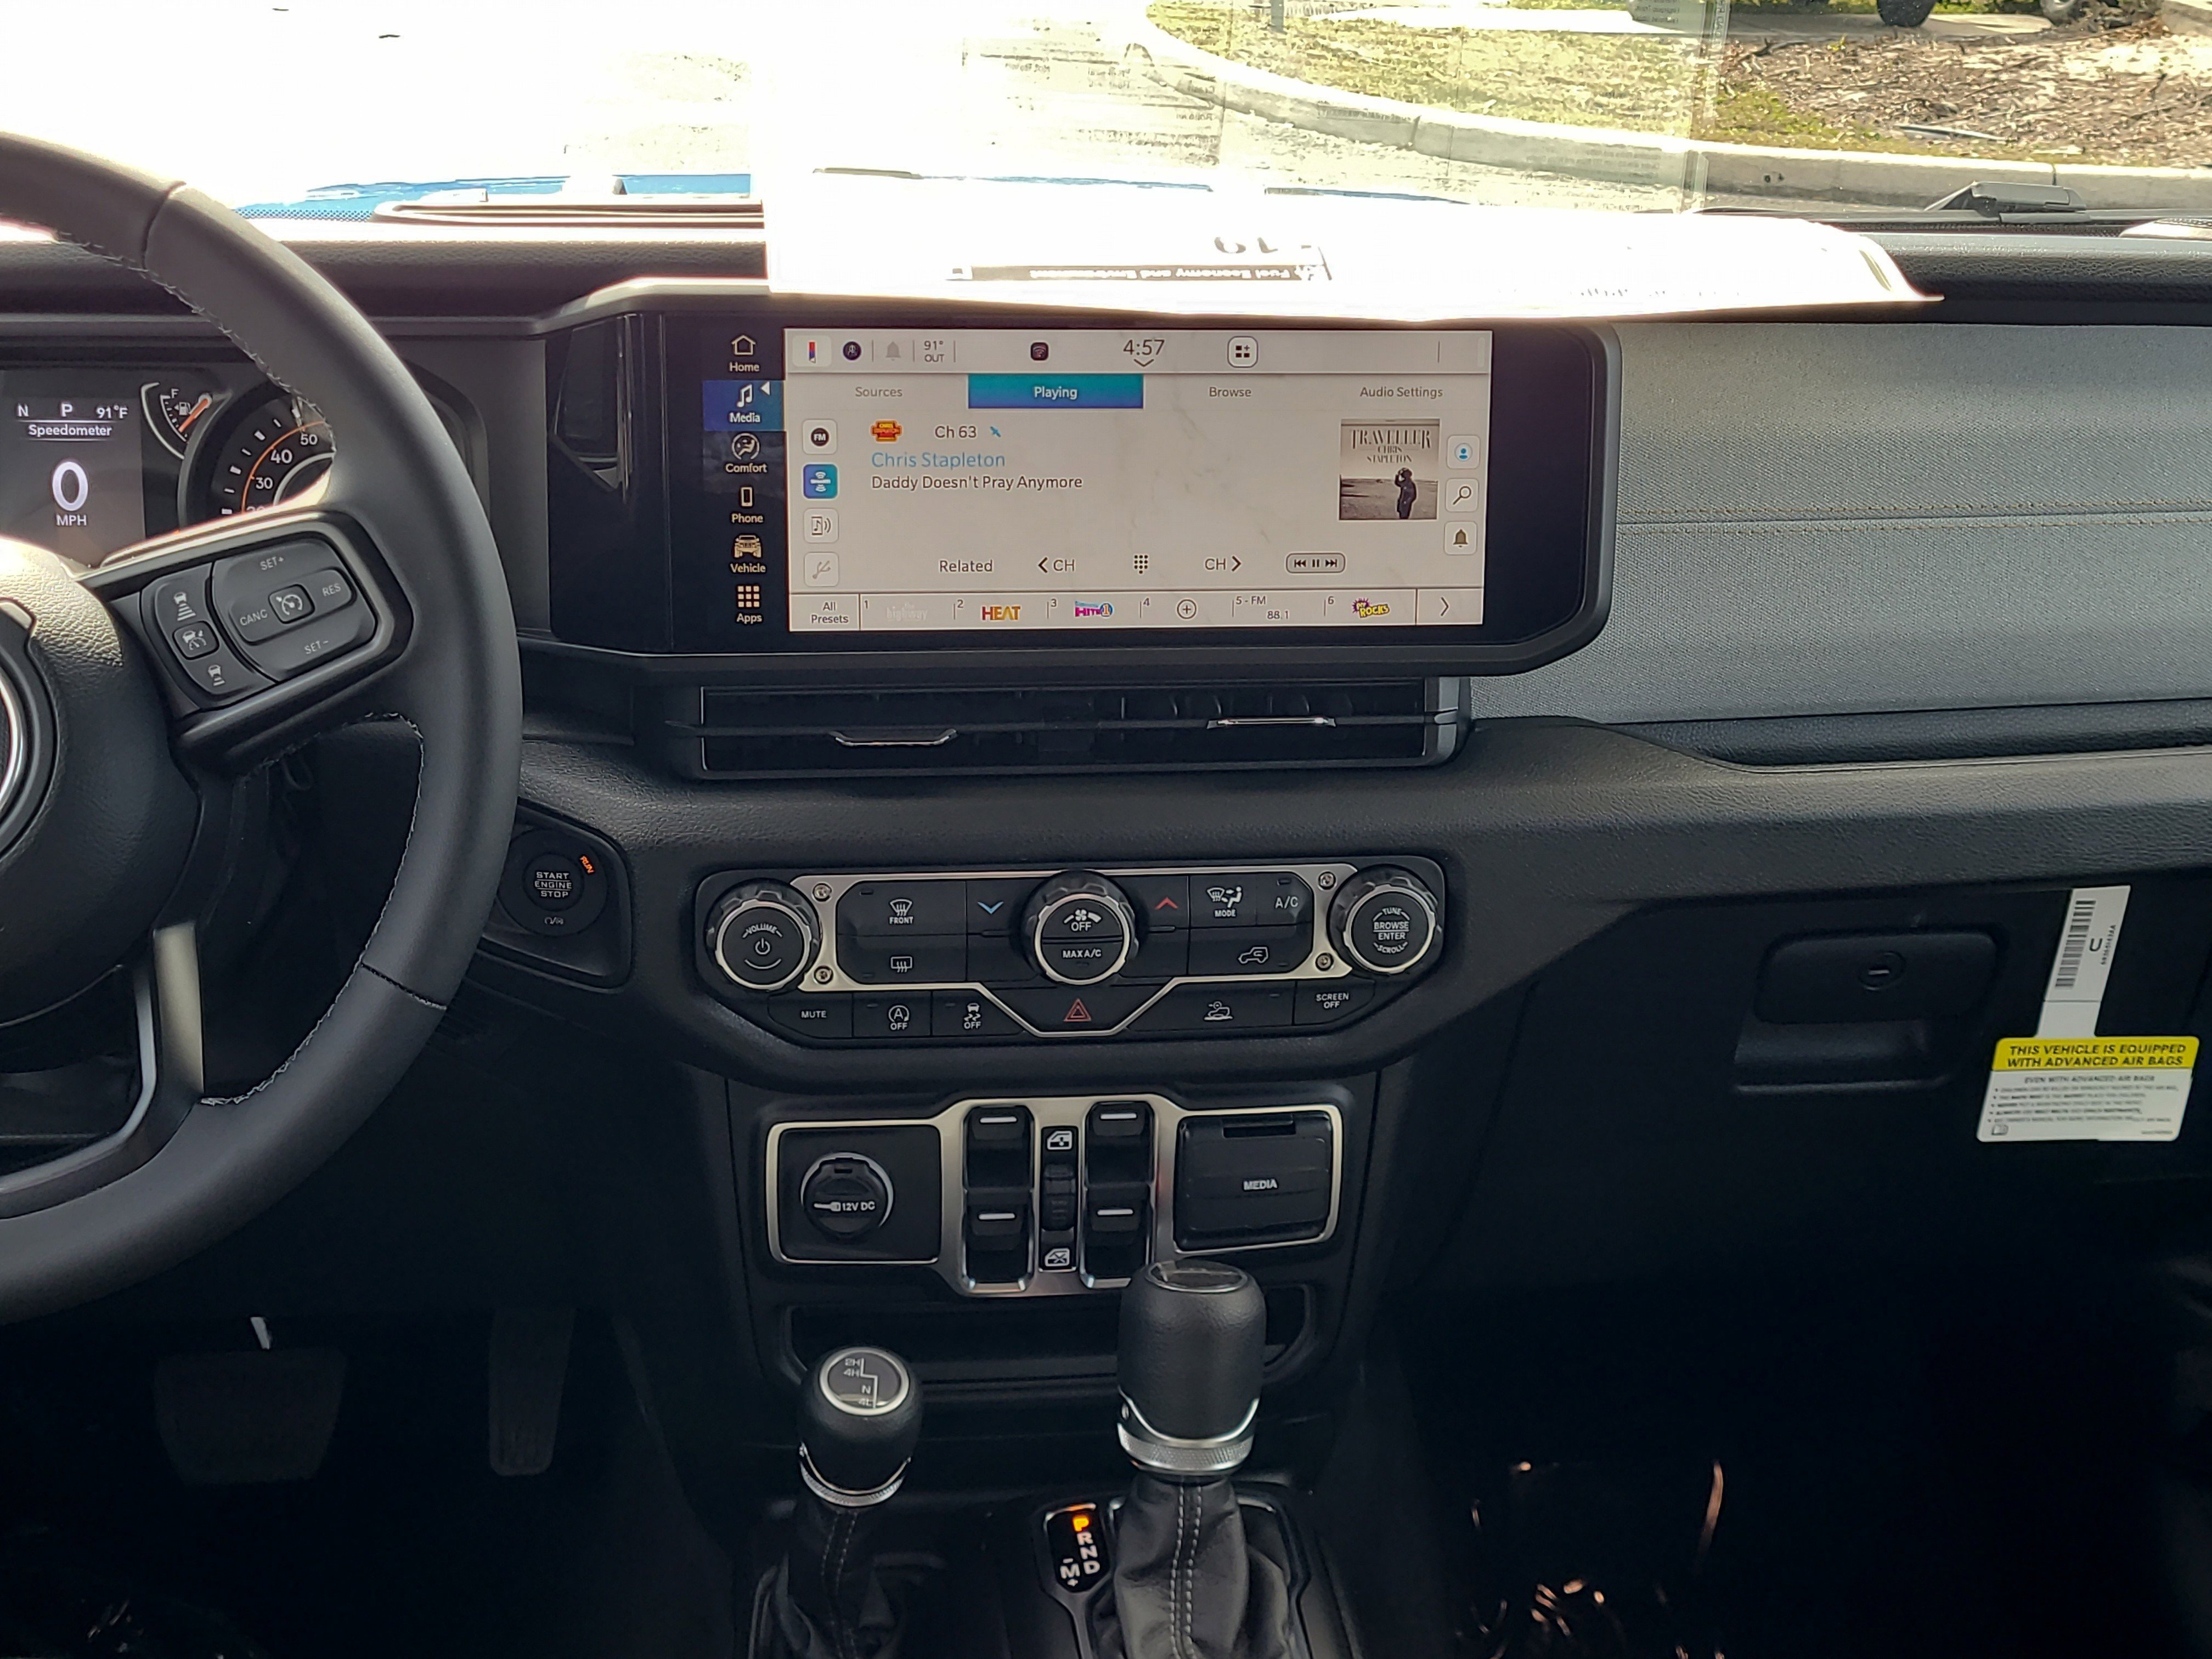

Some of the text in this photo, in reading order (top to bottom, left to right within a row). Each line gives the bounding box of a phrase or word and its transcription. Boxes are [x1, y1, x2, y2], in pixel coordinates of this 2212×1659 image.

[1123, 340, 1165, 356] 4:57
[924, 353, 945, 363] OUT
[730, 362, 760, 373] Home
[171, 388, 179, 399] F
[855, 386, 903, 398] Sources
[1034, 386, 1077, 400] Playing
[1209, 387, 1251, 398] Browse
[1360, 387, 1443, 400] Audio Settings
[18, 404, 29, 417] N
[61, 403, 73, 417] P
[730, 412, 761, 424] Media
[29, 424, 112, 438] Speedometer
[935, 425, 977, 438] Ch 63
[300, 434, 318, 445] 50
[813, 433, 827, 441] FM
[271, 449, 292, 463] 40
[871, 452, 1005, 470] Chris Stapleton
[725, 462, 767, 473] Comfort
[53, 461, 88, 511] 0
[256, 477, 273, 489] 30
[872, 476, 1083, 491] Daddy Doesn't Pray Anymore
[57, 514, 87, 526] MPH
[731, 512, 764, 524] Phone
[730, 562, 766, 574] Vehicle
[939, 560, 993, 572] Related
[1053, 560, 1075, 572] CH
[1205, 559, 1226, 571] CH
[322, 583, 341, 597] RES
[823, 601, 837, 611] All
[864, 600, 868, 609] 1
[957, 599, 964, 608] 2
[1051, 599, 1057, 607] 3
[1143, 597, 1150, 606] 4
[1236, 596, 1242, 605] 5
[1251, 596, 1266, 605] FM
[1328, 596, 1334, 605] 6
[981, 606, 1021, 621] HEAT
[1267, 610, 1289, 620] 88.1
[1360, 605, 1389, 617] ROCKS
[240, 608, 268, 627] CANC
[736, 613, 763, 624] Apps
[811, 614, 849, 624] Presets
[579, 855, 594, 874] RUN
[537, 871, 569, 879] START
[534, 881, 572, 889] ENGINE
[541, 890, 568, 898] STOP
[1275, 895, 1299, 910] A/C
[1215, 909, 1237, 918] MODE
[1382, 907, 1402, 915] TUNE
[889, 916, 913, 925] FRONT
[1373, 921, 1409, 930] BROWSE
[745, 923, 778, 935] VOLUME
[1071, 921, 1092, 932] OFF
[1378, 932, 1406, 940] ENTER
[1062, 949, 1102, 958] MAX A/C
[1377, 945, 1405, 953] SCROLL
[1316, 992, 1350, 1001] SCREEN
[1323, 1001, 1340, 1009] OFF
[801, 1009, 827, 1019] MUTE
[890, 1022, 909, 1031] OFF
[964, 1020, 981, 1030] OFF
[2010, 1043, 2187, 1056] THIS VEHICLE IS EQUIPPED
[2007, 1055, 2184, 1068] WITH ADVANCED AIR BAGS
[1242, 1177, 1278, 1191] MEDIA
[842, 1200, 876, 1211] 12V DC
[842, 1369, 861, 1378] 4H
[861, 1384, 872, 1395] N
[1073, 1517, 1089, 1532] P
[1077, 1532, 1093, 1545] R
[1080, 1545, 1098, 1559] N
[1060, 1564, 1080, 1579] M
[1084, 1560, 1101, 1575] D
